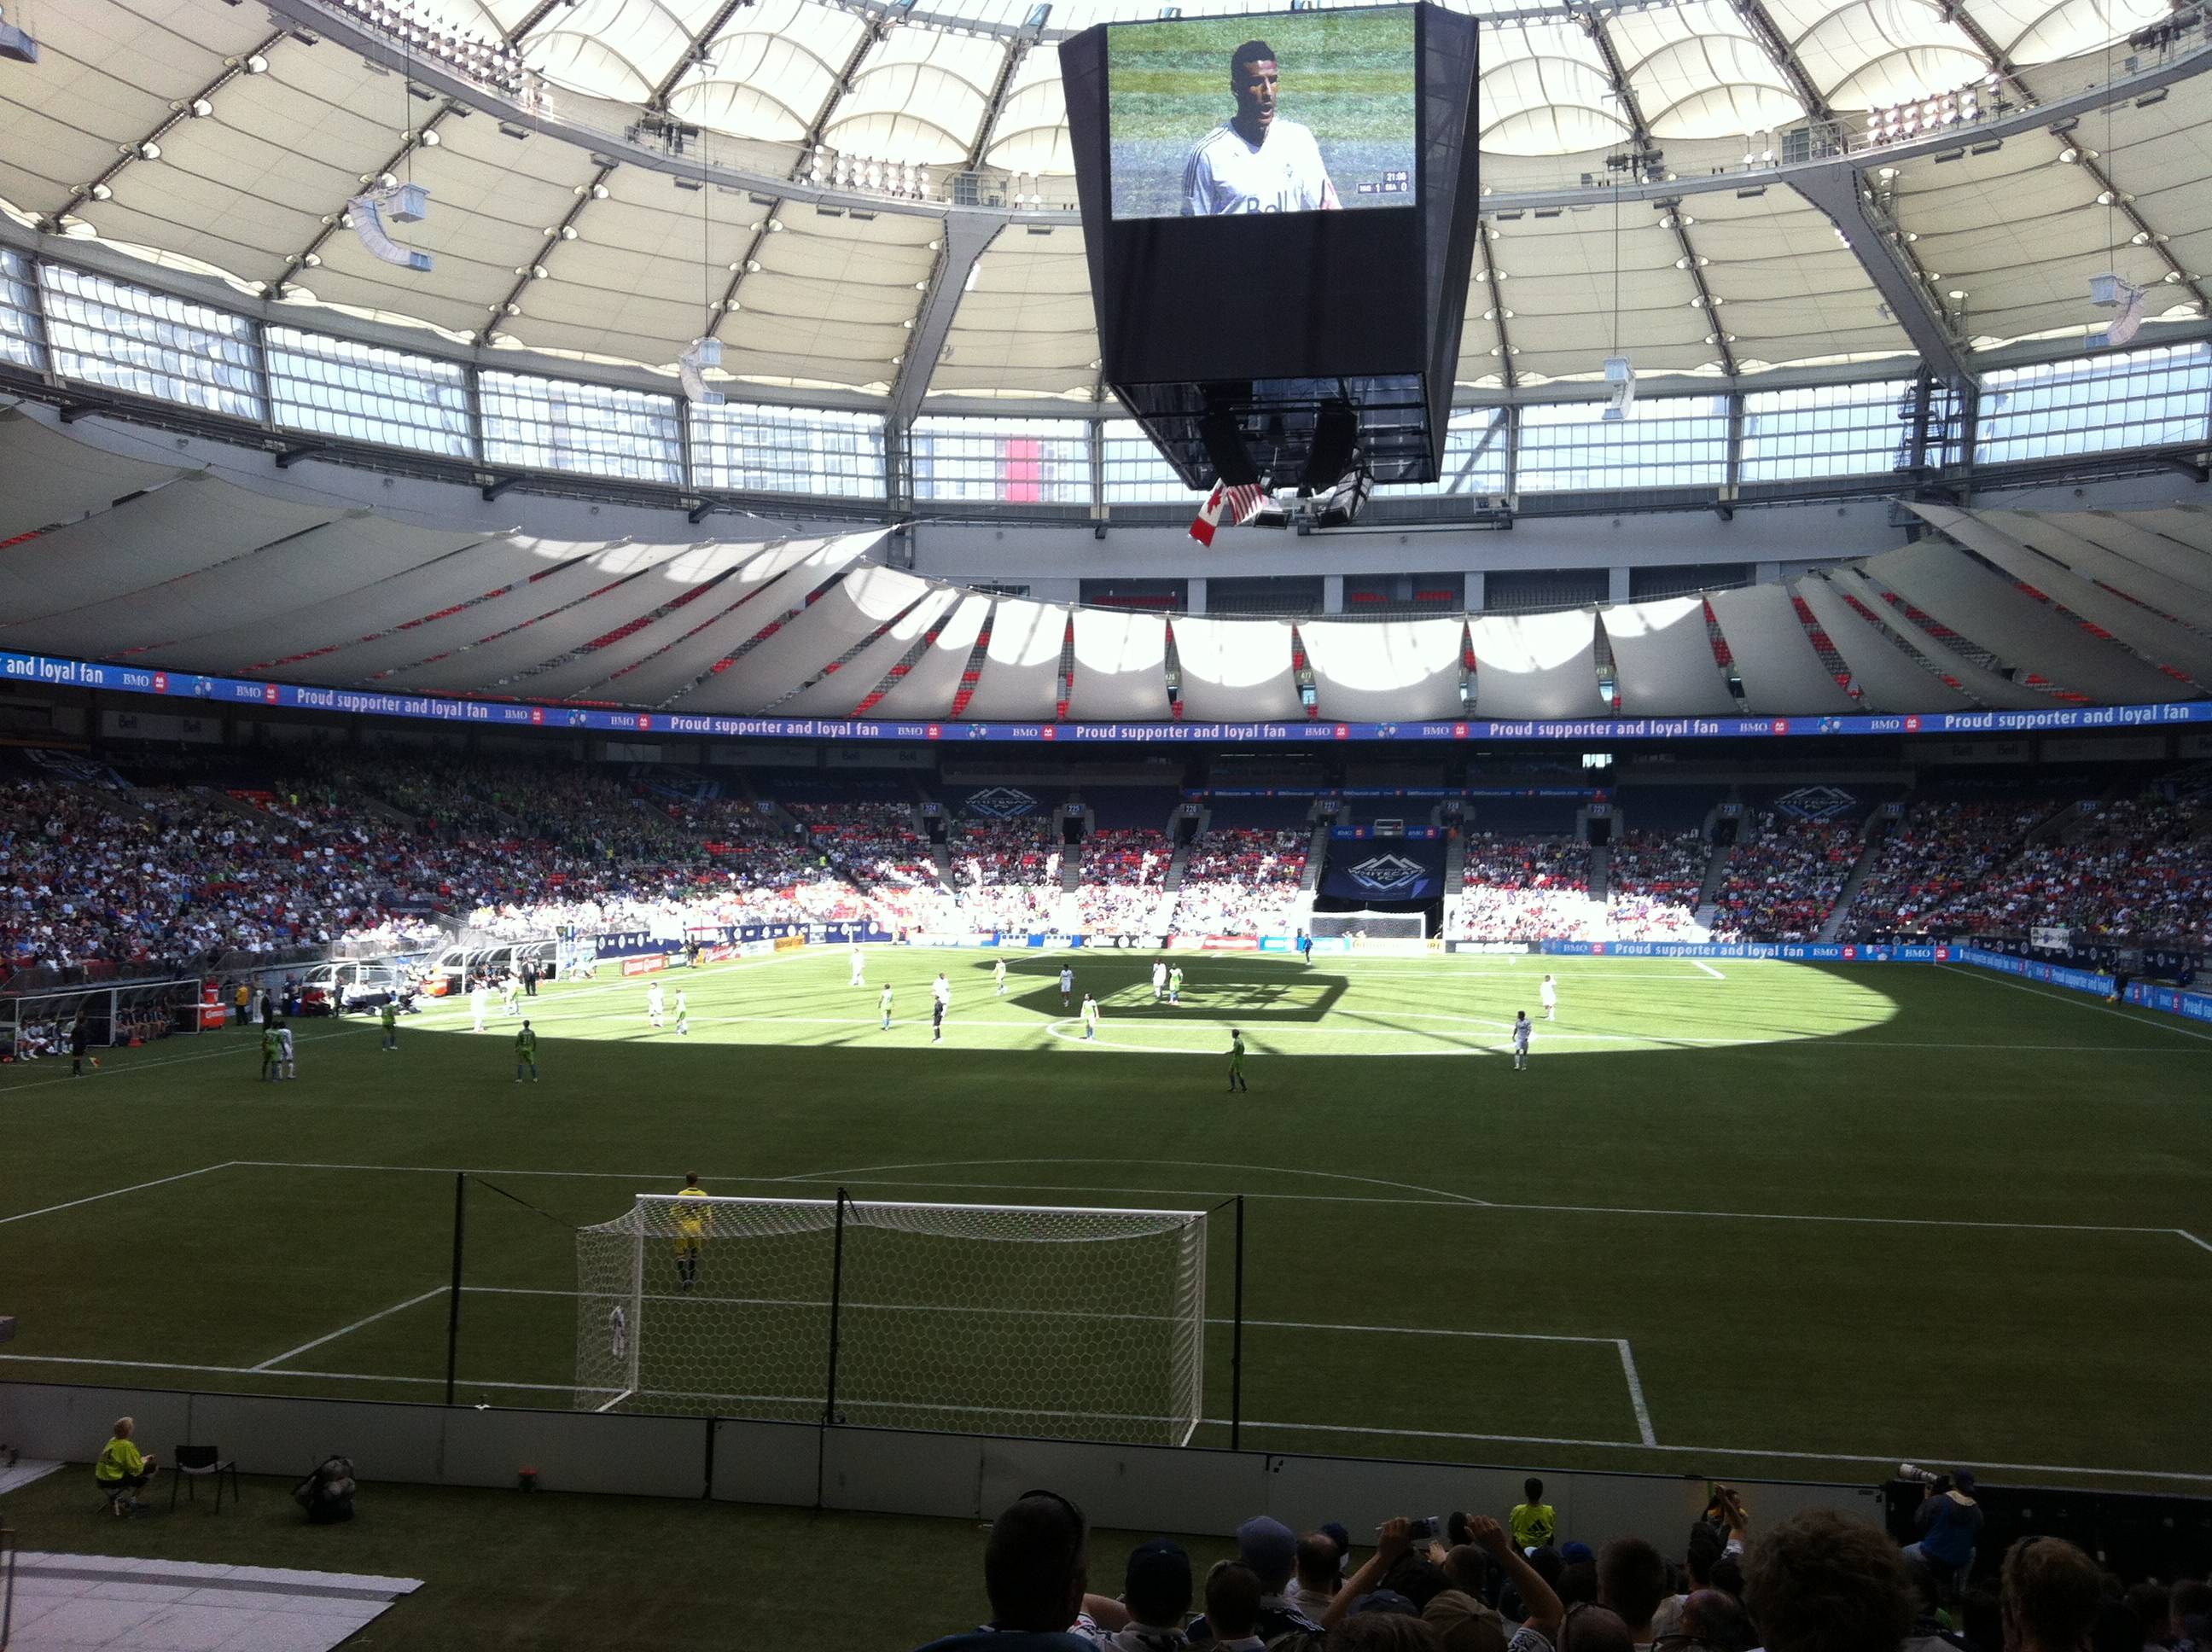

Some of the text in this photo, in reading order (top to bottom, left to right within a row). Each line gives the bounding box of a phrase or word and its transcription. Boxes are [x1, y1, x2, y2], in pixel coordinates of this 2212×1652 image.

[7, 656, 103, 683] and loyal fan
[123, 673, 149, 687] BMO
[236, 685, 261, 698] BMO
[298, 688, 487, 718] Proud supporter and loyal fan
[504, 709, 527, 719] BMO
[1945, 703, 2189, 730] Proud supporter and loyal fan
[611, 716, 634, 726] BMO
[1871, 719, 1900, 730] BMO
[671, 716, 878, 738] Proud supporter and loyal fan
[898, 726, 923, 736] BMO
[1013, 728, 1038, 737] BMO
[1076, 724, 1285, 741] Proud supporter and loyal fan
[1305, 727, 1330, 736] BMO
[1423, 726, 1449, 736] BMO
[1490, 718, 1719, 739] Proud supporter and loyal fan
[1739, 722, 1767, 732] BMO
[1615, 944, 1804, 957] Proud supporter and loyal fan
[1813, 948, 1838, 957] BMO
[1905, 948, 1930, 957] BMO
